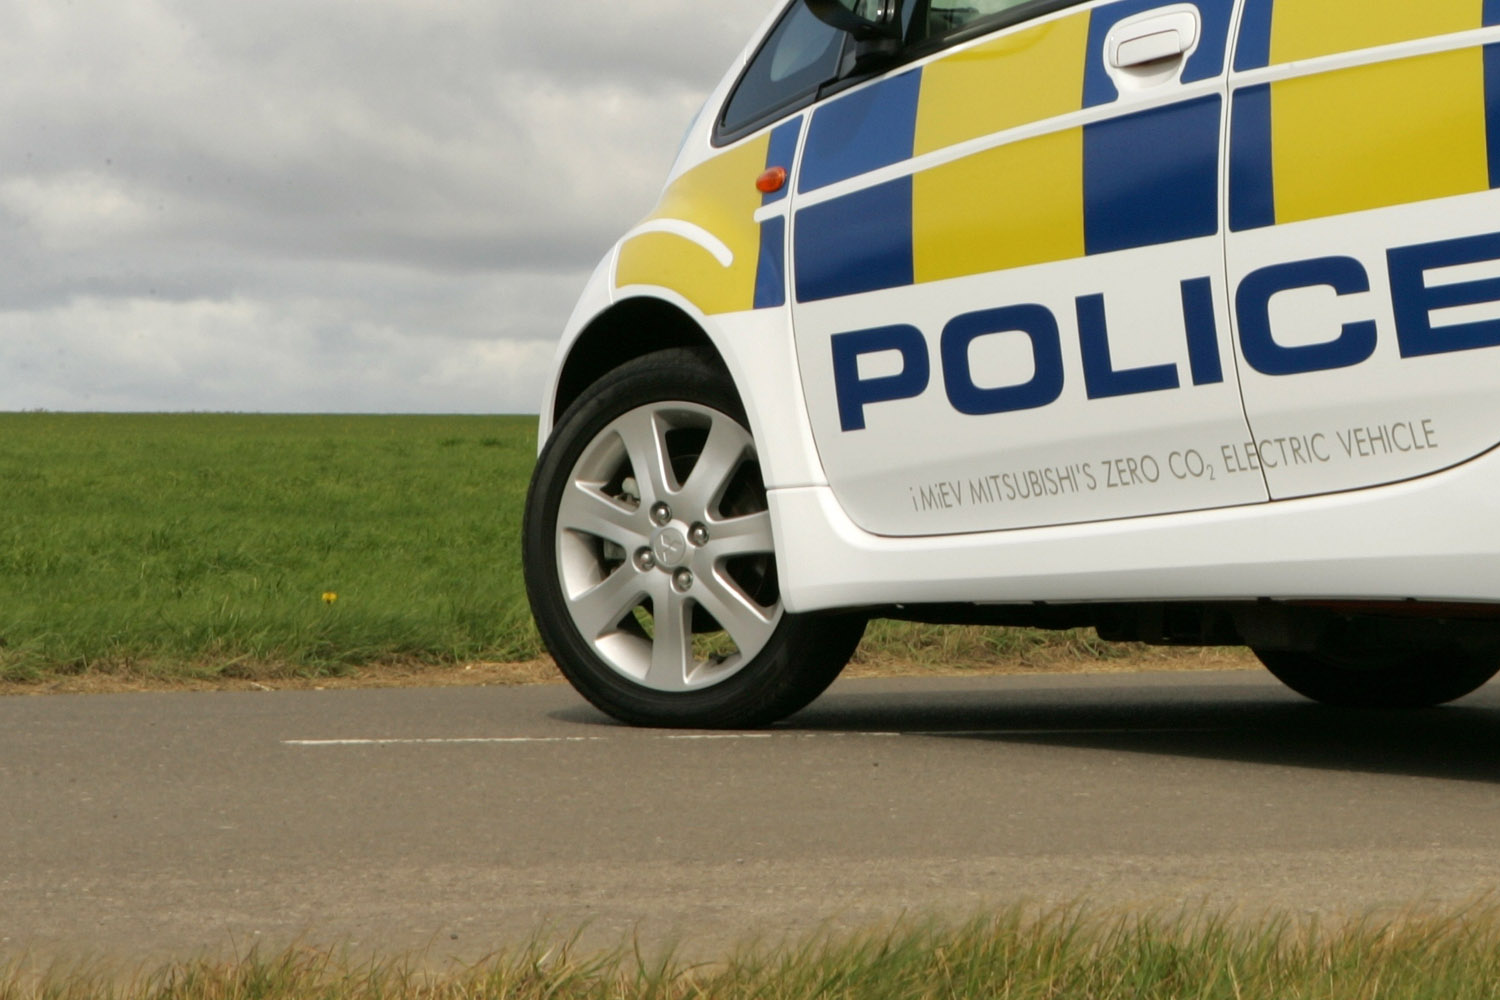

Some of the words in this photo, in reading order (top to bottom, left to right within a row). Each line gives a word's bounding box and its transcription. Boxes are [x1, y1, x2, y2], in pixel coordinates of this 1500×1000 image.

[968, 462, 1098, 505] MITSUBISHI'S
[1101, 454, 1161, 488] ZERO
[1220, 432, 1331, 473] ELECTRIC
[1335, 418, 1439, 458] VEHICLE
